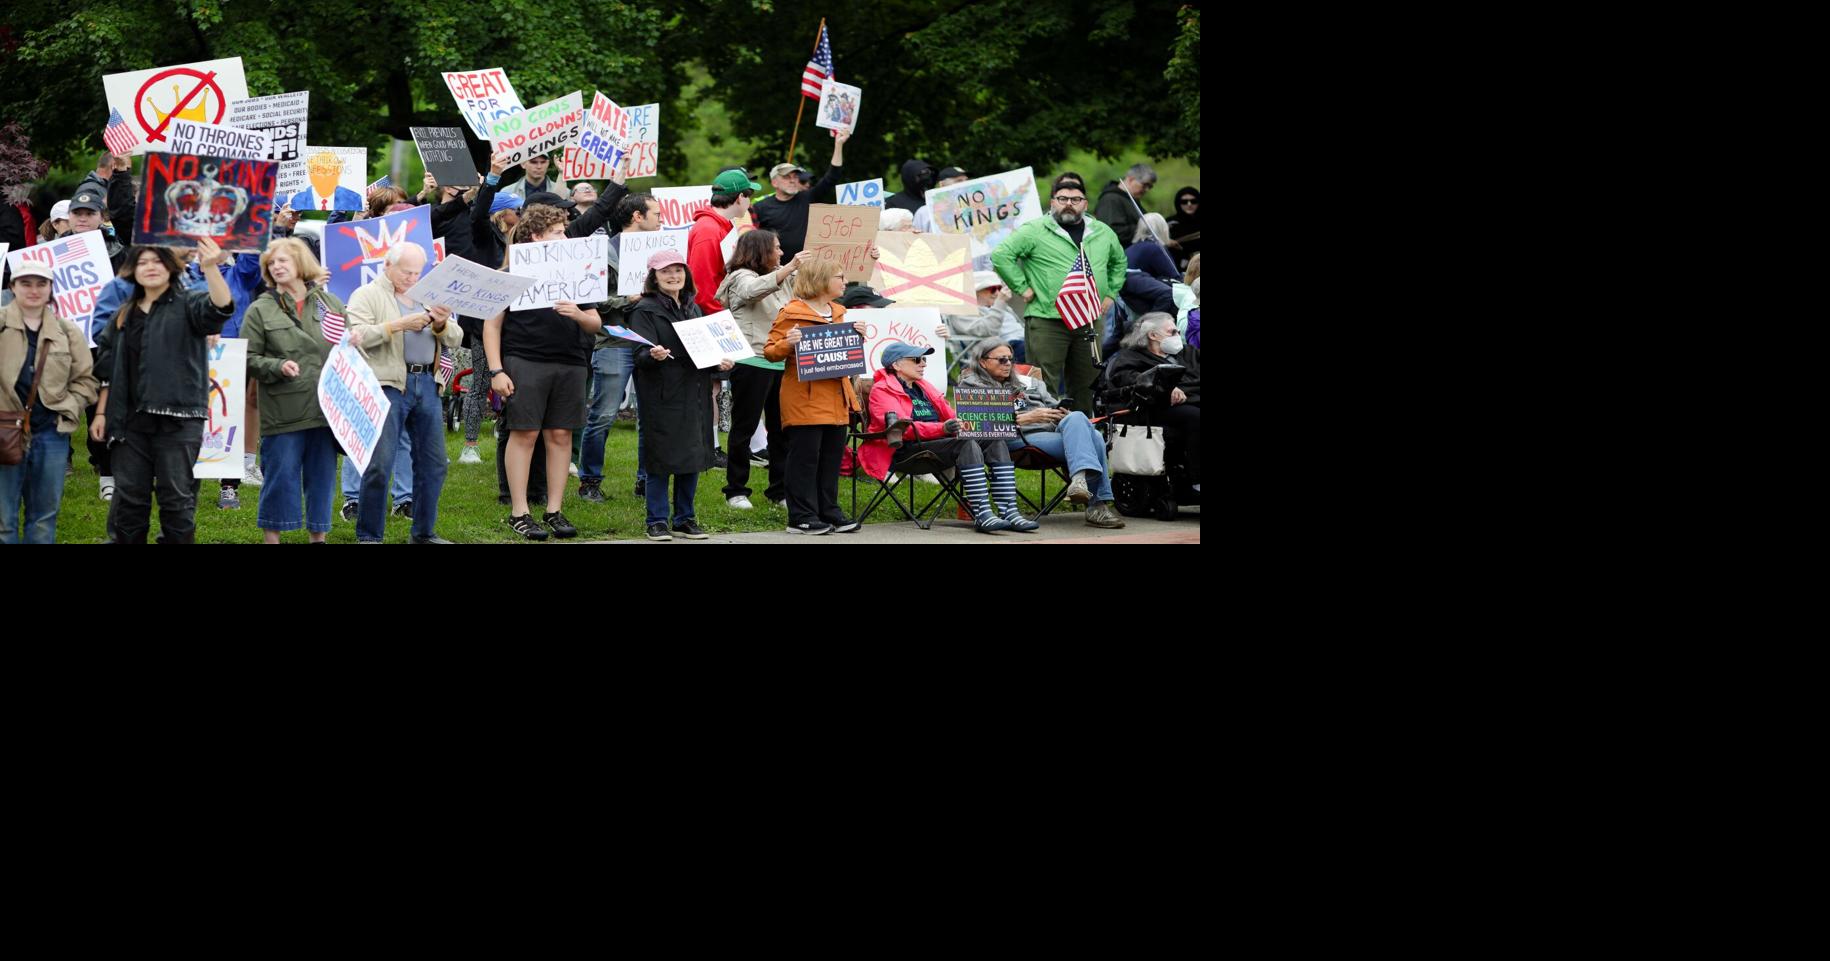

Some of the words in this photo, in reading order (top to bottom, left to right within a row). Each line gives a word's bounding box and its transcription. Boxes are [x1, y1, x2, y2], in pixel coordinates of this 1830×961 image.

[448, 71, 506, 99] GREAT
[247, 103, 267, 111] BODIES
[273, 100, 300, 108] MEDICAID
[467, 98, 500, 110] FOR
[493, 117, 522, 136] NO
[528, 100, 570, 123] CONS
[592, 94, 627, 138] HATE
[174, 123, 195, 139] NO
[200, 126, 264, 151] THRONES
[414, 128, 428, 138] EVIL
[428, 128, 456, 138] PREVAILS
[498, 134, 526, 152] NO
[529, 109, 582, 140] CLOWNS
[528, 126, 578, 157] KINGS
[172, 140, 192, 154] NO
[433, 140, 446, 148] GOOD
[581, 131, 624, 168] GREAT
[422, 150, 452, 162] NOTHING
[564, 148, 595, 179] EGG
[840, 182, 879, 204] NO
[958, 190, 985, 208] NO
[658, 197, 680, 226] NO
[954, 201, 1020, 230] KINGS
[625, 237, 641, 252] NO
[646, 235, 676, 248] KINGS
[515, 246, 541, 265] NO
[53, 261, 99, 293] NGS
[451, 264, 480, 280] THERE
[424, 291, 438, 300] IN
[443, 297, 495, 313] AMERICA
[448, 280, 472, 293] NO
[474, 288, 510, 302] KINGS
[519, 278, 604, 306] AMERICA
[706, 322, 724, 338] NO
[864, 324, 878, 342] O
[717, 338, 743, 353] KING
[799, 340, 811, 352] ARE
[812, 339, 823, 350] WE
[824, 336, 843, 348] GREAT
[845, 334, 860, 346] YET?
[814, 351, 848, 363] 'CAUSE
[827, 361, 863, 370] embarrassed
[335, 352, 357, 390] LIKE
[322, 391, 340, 429] WHAT
[326, 372, 375, 448] DEMOCRACY
[355, 382, 382, 428] LOOKS
[958, 413, 988, 421] SCIENCE
[989, 413, 996, 421] IS
[997, 413, 1014, 421] REAL
[339, 420, 350, 440] IS
[348, 436, 367, 465] THIS
